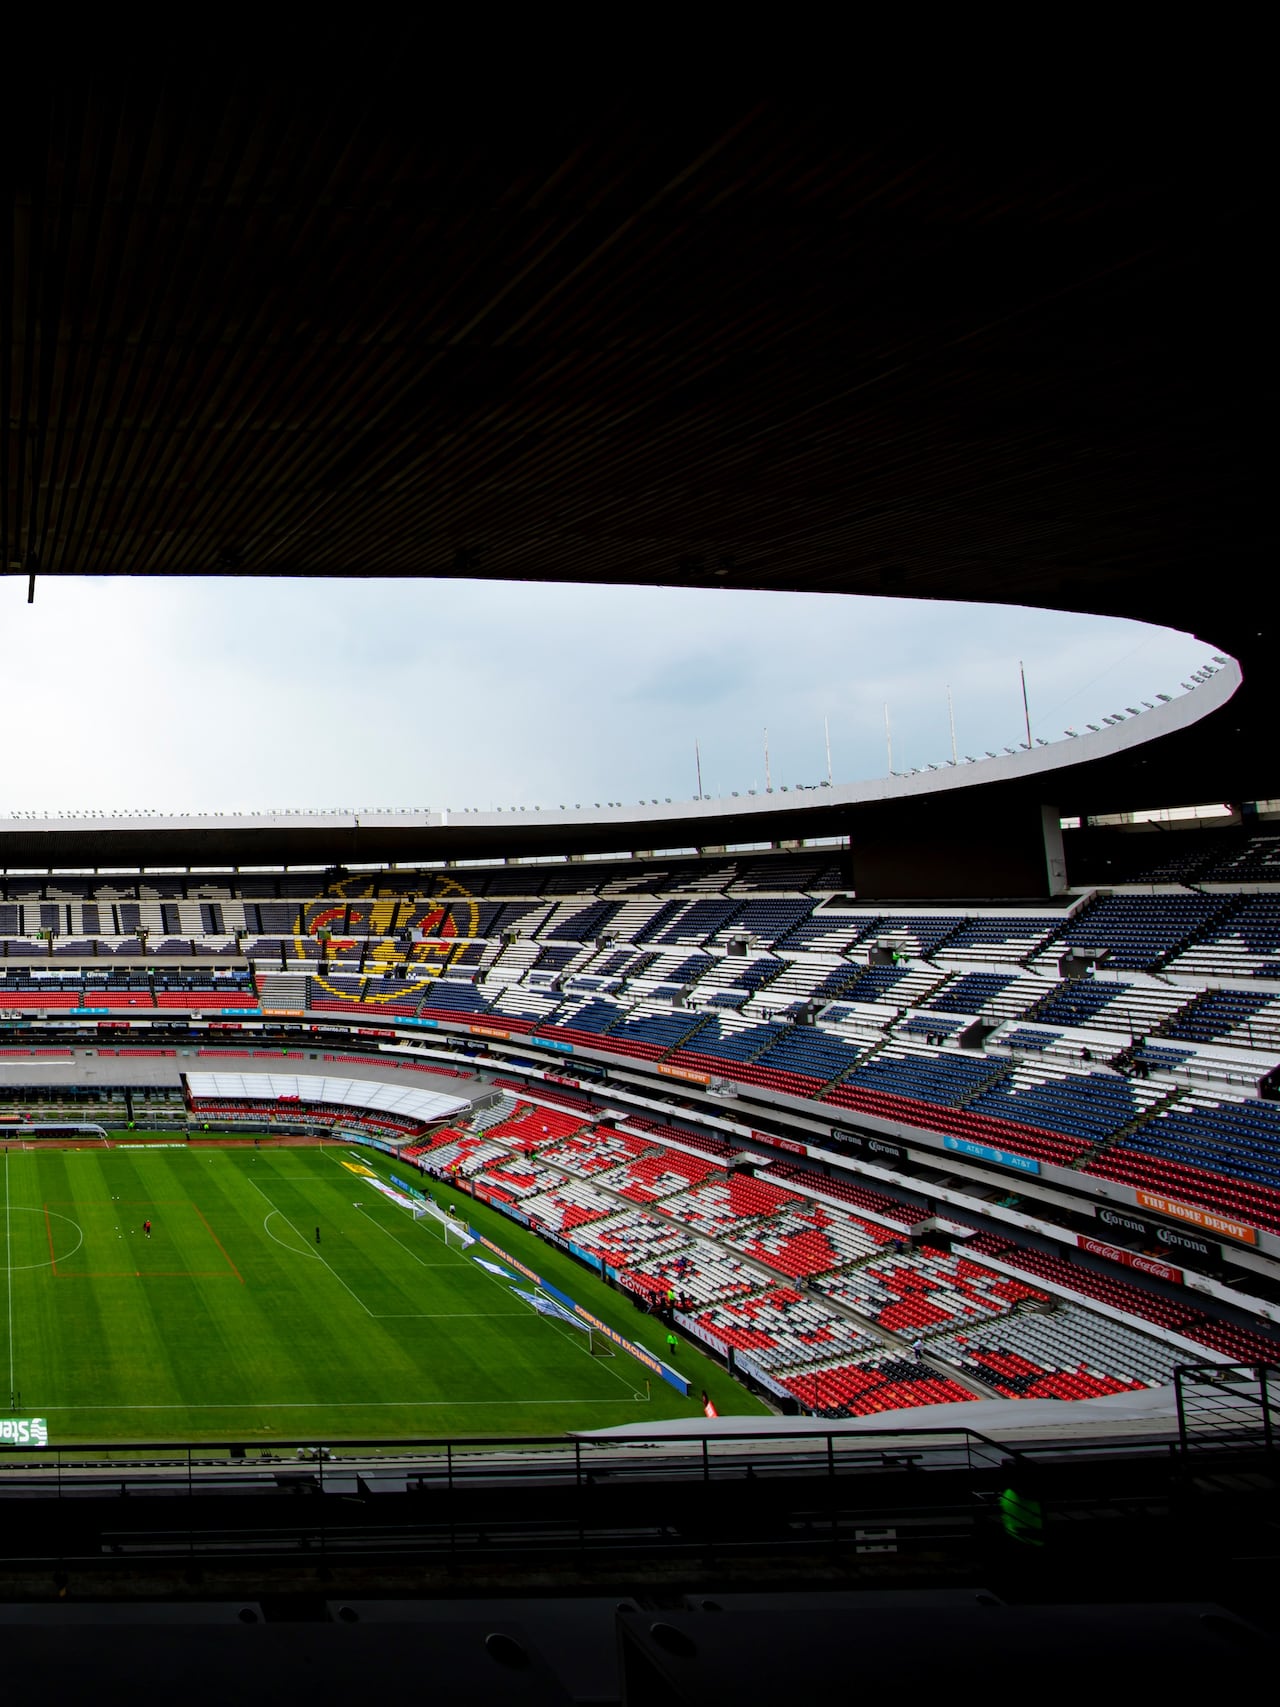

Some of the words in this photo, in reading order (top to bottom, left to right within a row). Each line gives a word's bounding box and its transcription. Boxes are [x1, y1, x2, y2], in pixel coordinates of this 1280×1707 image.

[833, 1130, 862, 1146] Corona
[868, 1140, 900, 1156] Corona
[966, 1144, 985, 1155] AT&T
[1011, 1158, 1031, 1168] AT&T
[1099, 1209, 1146, 1234] Corona
[1156, 1228, 1208, 1254] Corona
[1142, 1194, 1166, 1211] THE
[1167, 1202, 1203, 1223] HOME
[1205, 1213, 1247, 1238] DEPOT
[574, 1304, 611, 1337] COMPLETAS
[611, 1331, 622, 1345] EN
[622, 1339, 663, 1375] EXCLUSIVA
